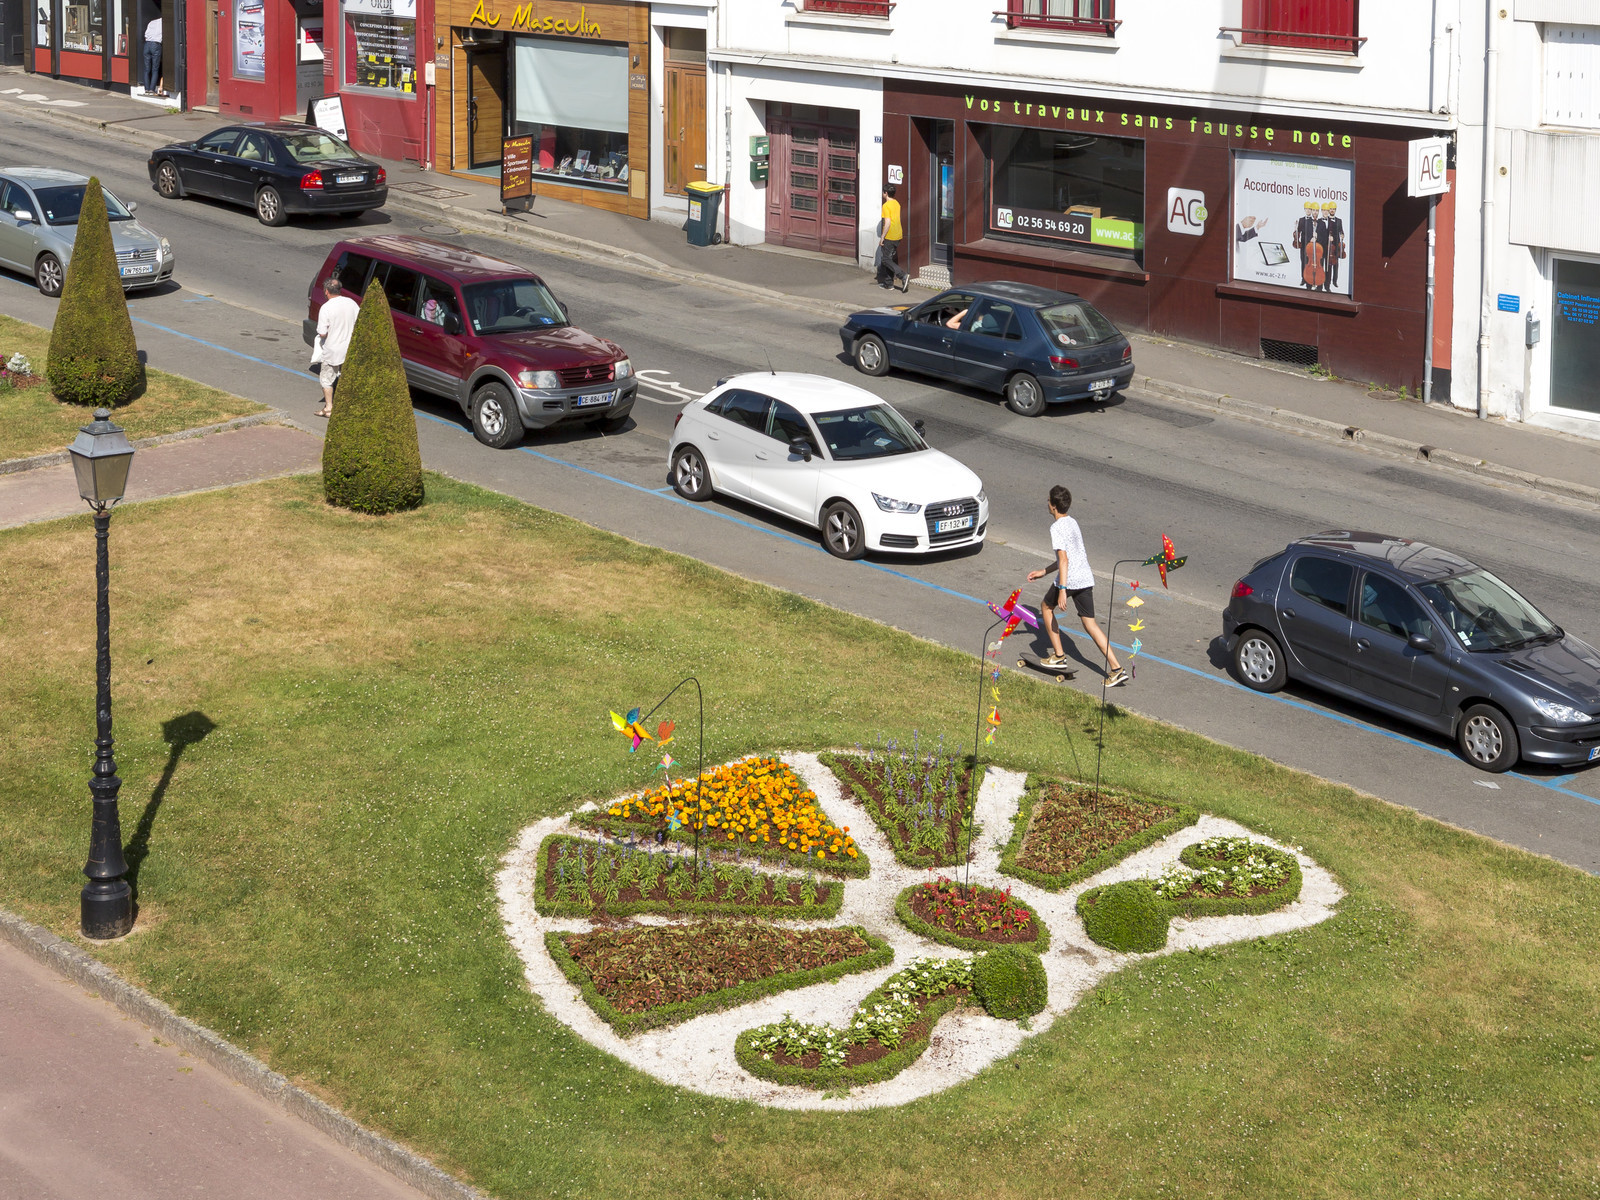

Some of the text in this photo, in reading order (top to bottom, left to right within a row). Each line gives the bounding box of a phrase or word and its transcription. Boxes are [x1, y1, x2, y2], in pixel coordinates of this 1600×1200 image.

[511, 2, 601, 36] Masculin
[965, 94, 1352, 149] Vos travaux sans fausse note
[889, 168, 902, 181] AC
[1420, 153, 1440, 182] AC
[1243, 177, 1348, 201] Accordons les violons
[999, 211, 1012, 224] AC
[1170, 196, 1202, 227] AC
[1018, 215, 1084, 235] 02 56 54 69 20
[1557, 291, 1580, 300] Cabinet
